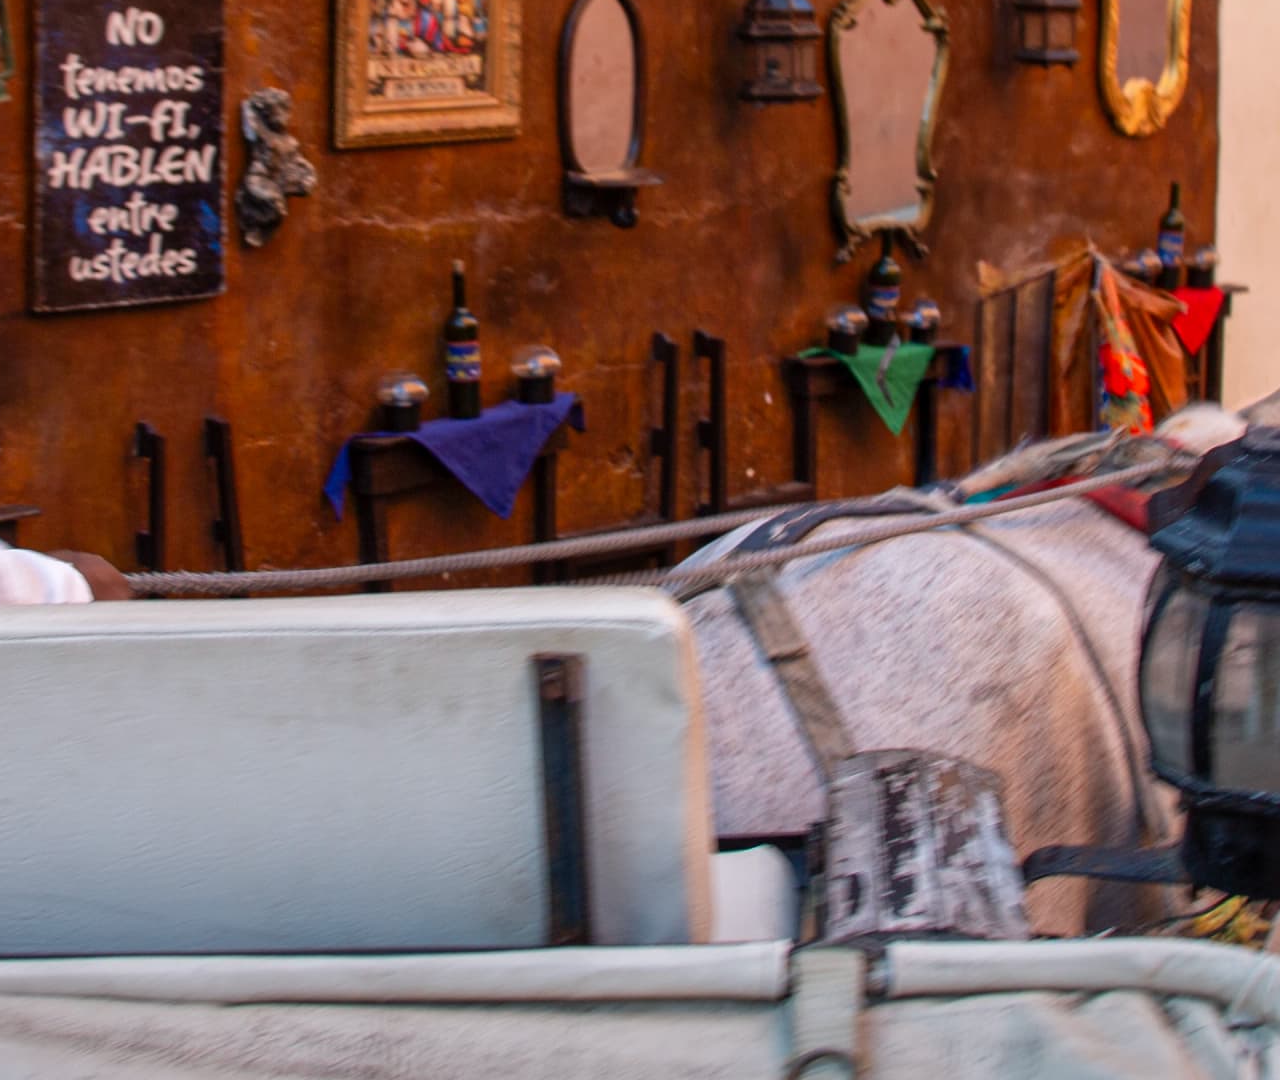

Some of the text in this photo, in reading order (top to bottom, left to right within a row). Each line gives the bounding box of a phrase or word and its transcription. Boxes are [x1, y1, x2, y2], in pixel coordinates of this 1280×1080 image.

[106, 7, 164, 46] NO
[59, 53, 205, 100] tenemos
[48, 144, 216, 190] HABLEN
[87, 191, 179, 236] entre
[69, 233, 197, 284] ustedes
